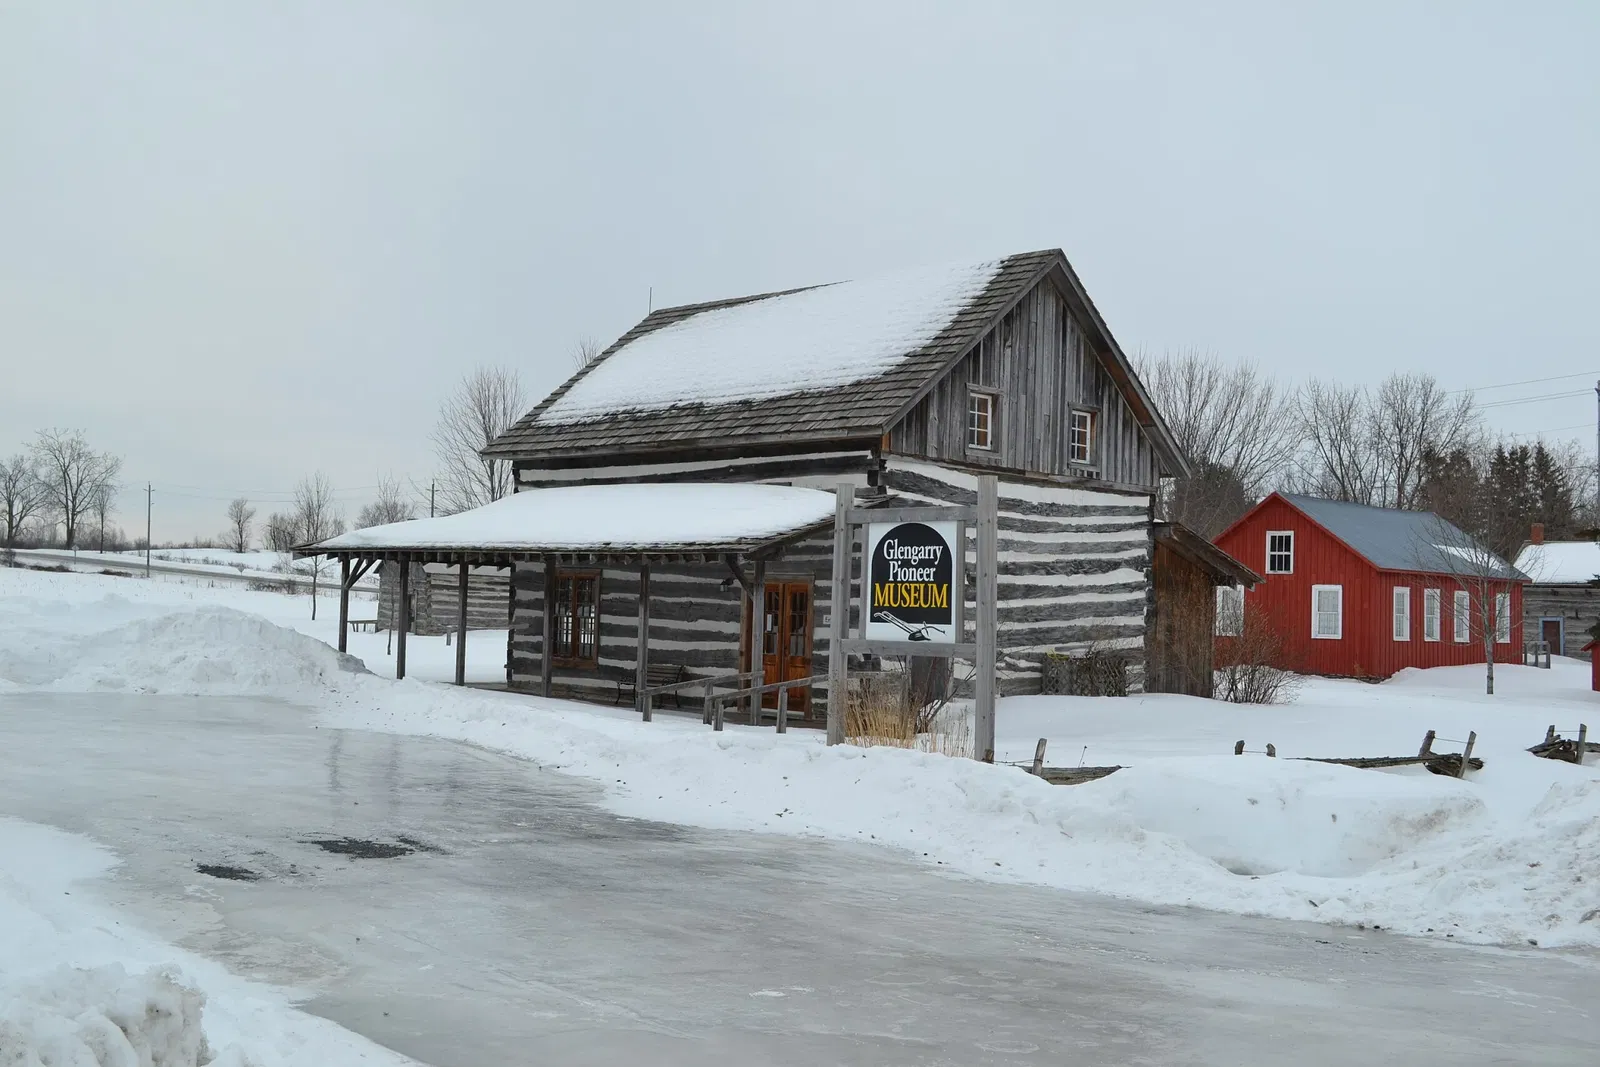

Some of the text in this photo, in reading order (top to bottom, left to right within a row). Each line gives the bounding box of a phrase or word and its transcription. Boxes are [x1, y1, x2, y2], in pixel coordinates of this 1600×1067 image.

[883, 538, 943, 565] Glengarry
[889, 561, 936, 581] Pioneer
[874, 583, 948, 608] MUSEUM
